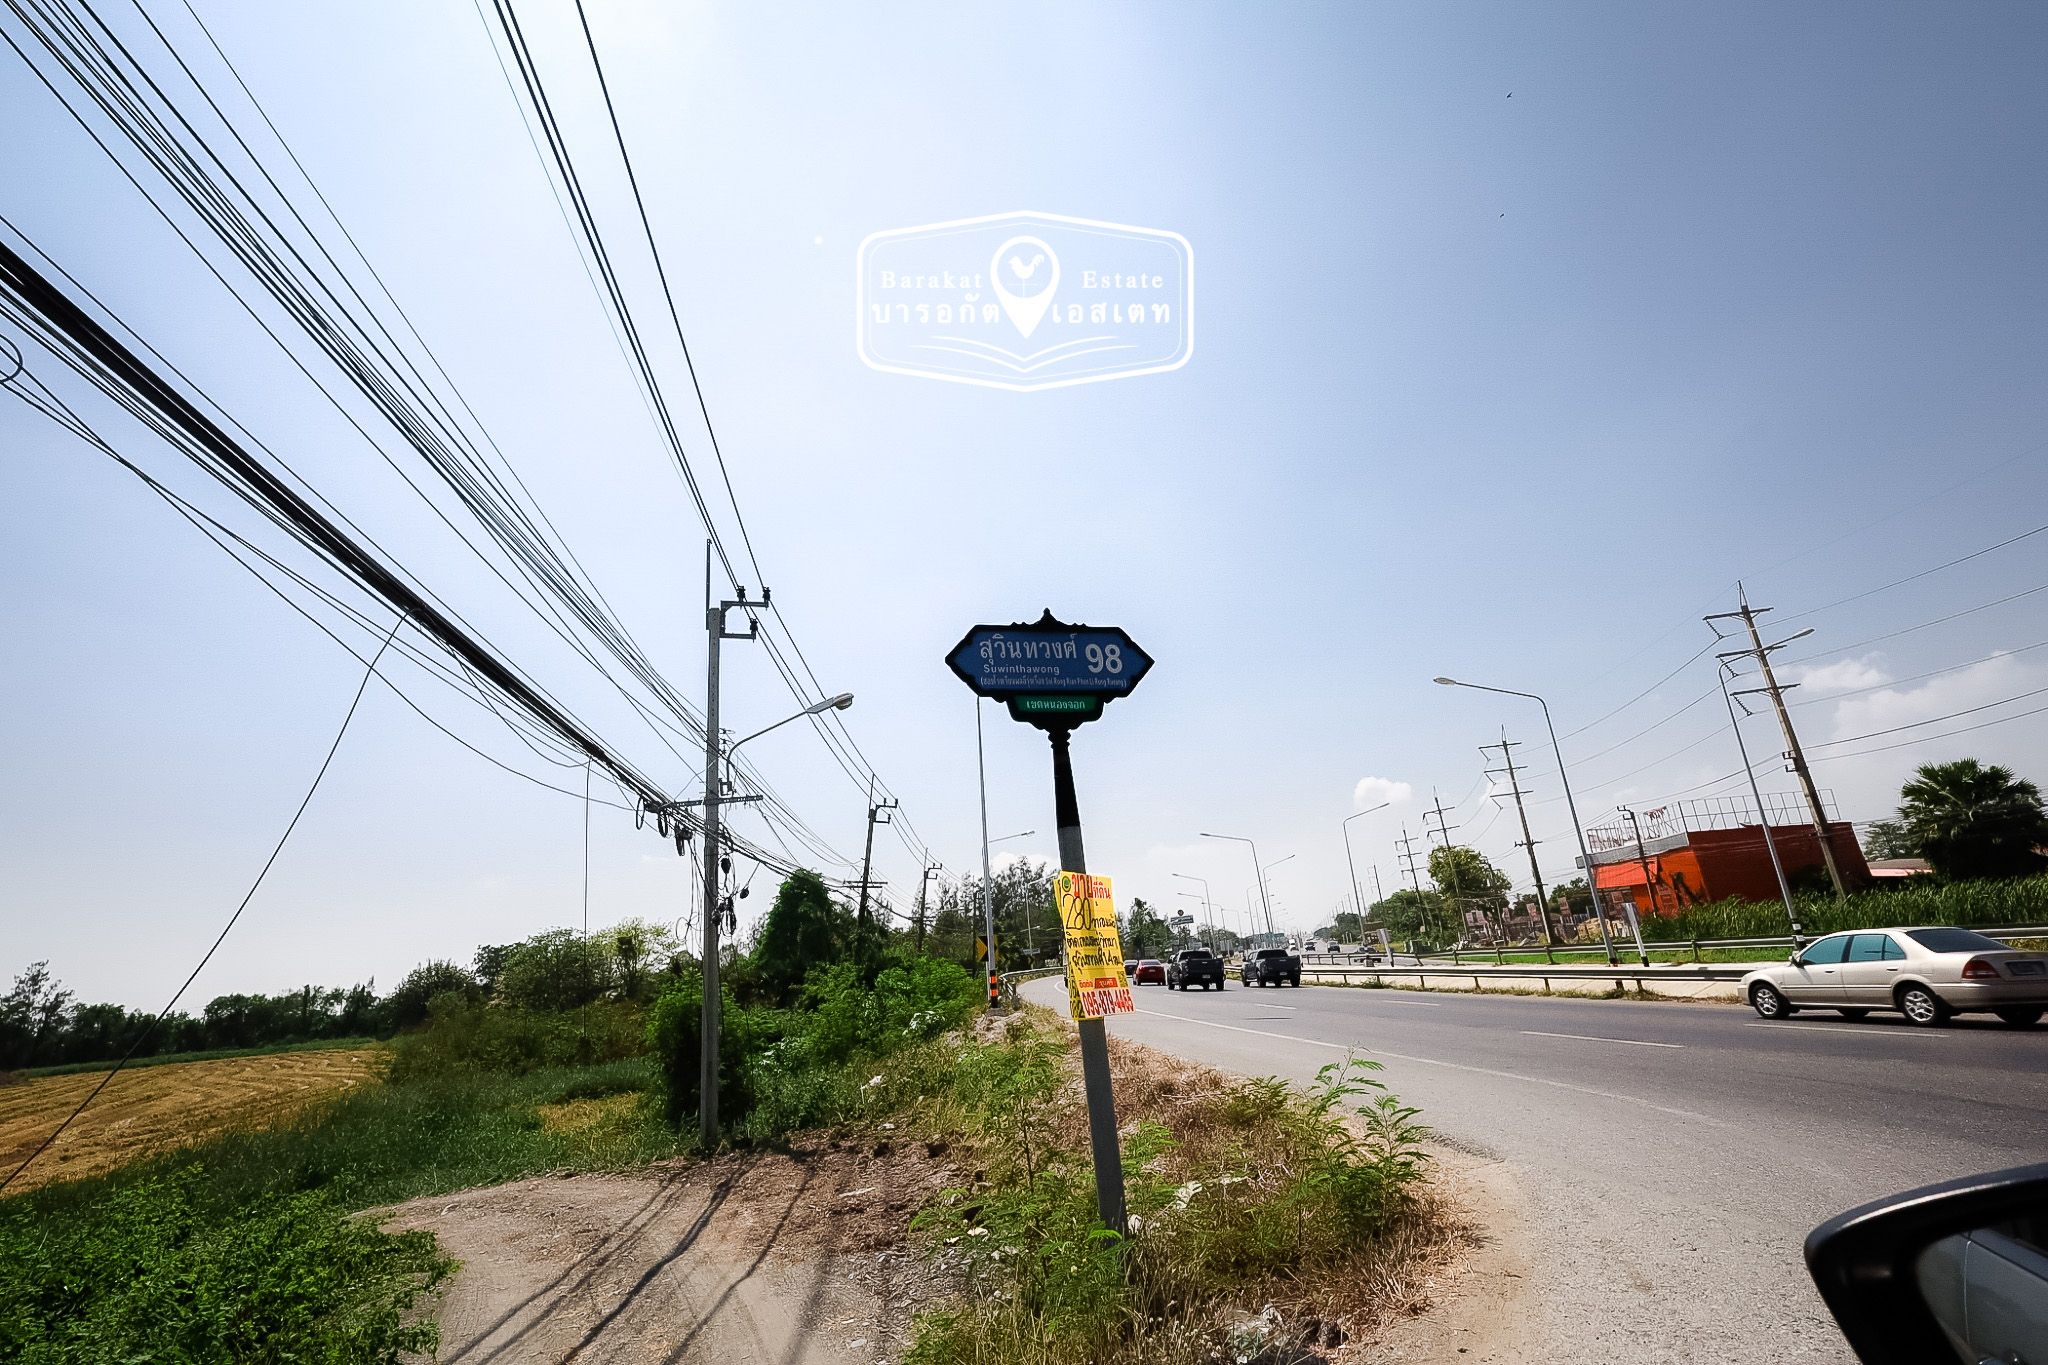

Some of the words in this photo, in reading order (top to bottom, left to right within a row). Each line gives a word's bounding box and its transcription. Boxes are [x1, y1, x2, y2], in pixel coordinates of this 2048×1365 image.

[979, 633, 1078, 665] สุวินทวงศ์
[1085, 643, 1123, 674] 98
[983, 664, 1060, 675] Suwinthawong
[1026, 700, 1086, 710] เขตหนองจอก
